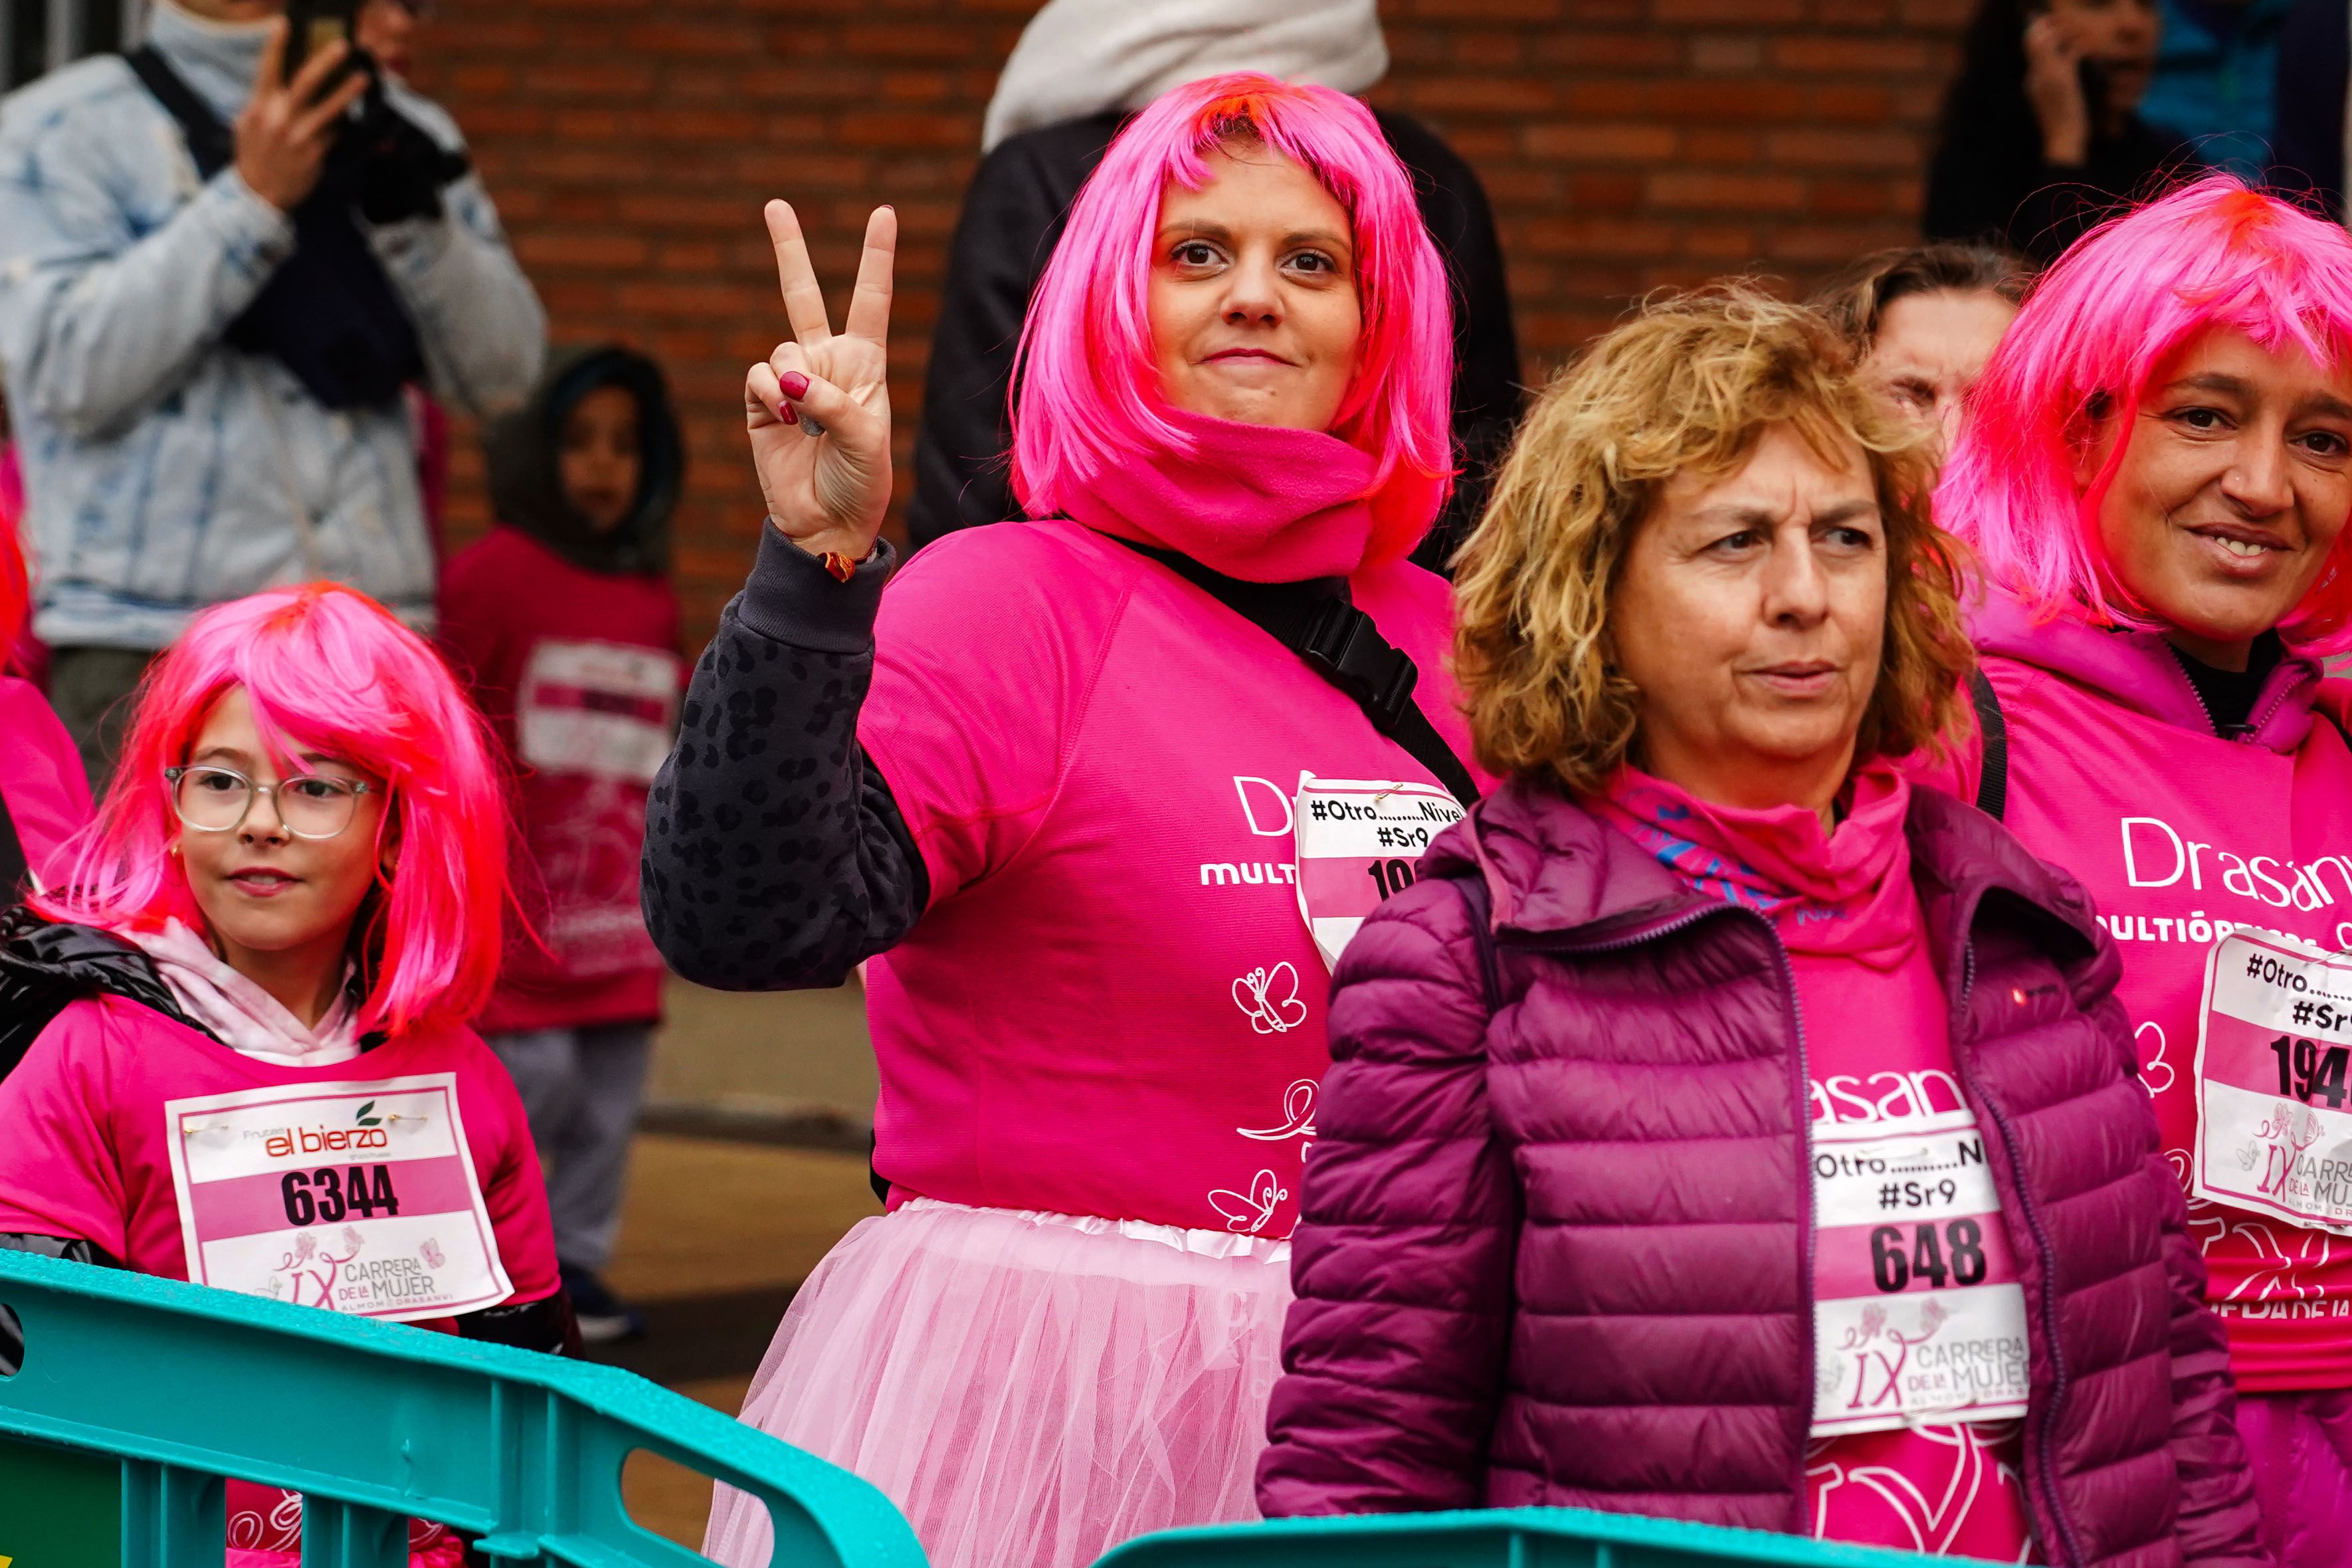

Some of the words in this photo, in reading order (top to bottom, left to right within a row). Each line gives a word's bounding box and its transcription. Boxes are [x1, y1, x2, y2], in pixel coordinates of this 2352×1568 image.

[1377, 827, 1428, 847] #Sr9
[1367, 858, 1420, 902] 10
[2293, 1001, 2352, 1031] #Sr
[2271, 1035, 2352, 1109] 194
[266, 1128, 294, 1157] el
[299, 1125, 387, 1153] bierzo
[281, 1164, 399, 1226] 6344
[1880, 1179, 1955, 1209] #Sr9
[2314, 1181, 2352, 1207] MU
[345, 1258, 421, 1282] CARRERA
[1871, 1218, 1986, 1293] 648
[339, 1286, 357, 1300] DE
[371, 1276, 435, 1299] MUJER
[1917, 1337, 2024, 1369] CARRERA
